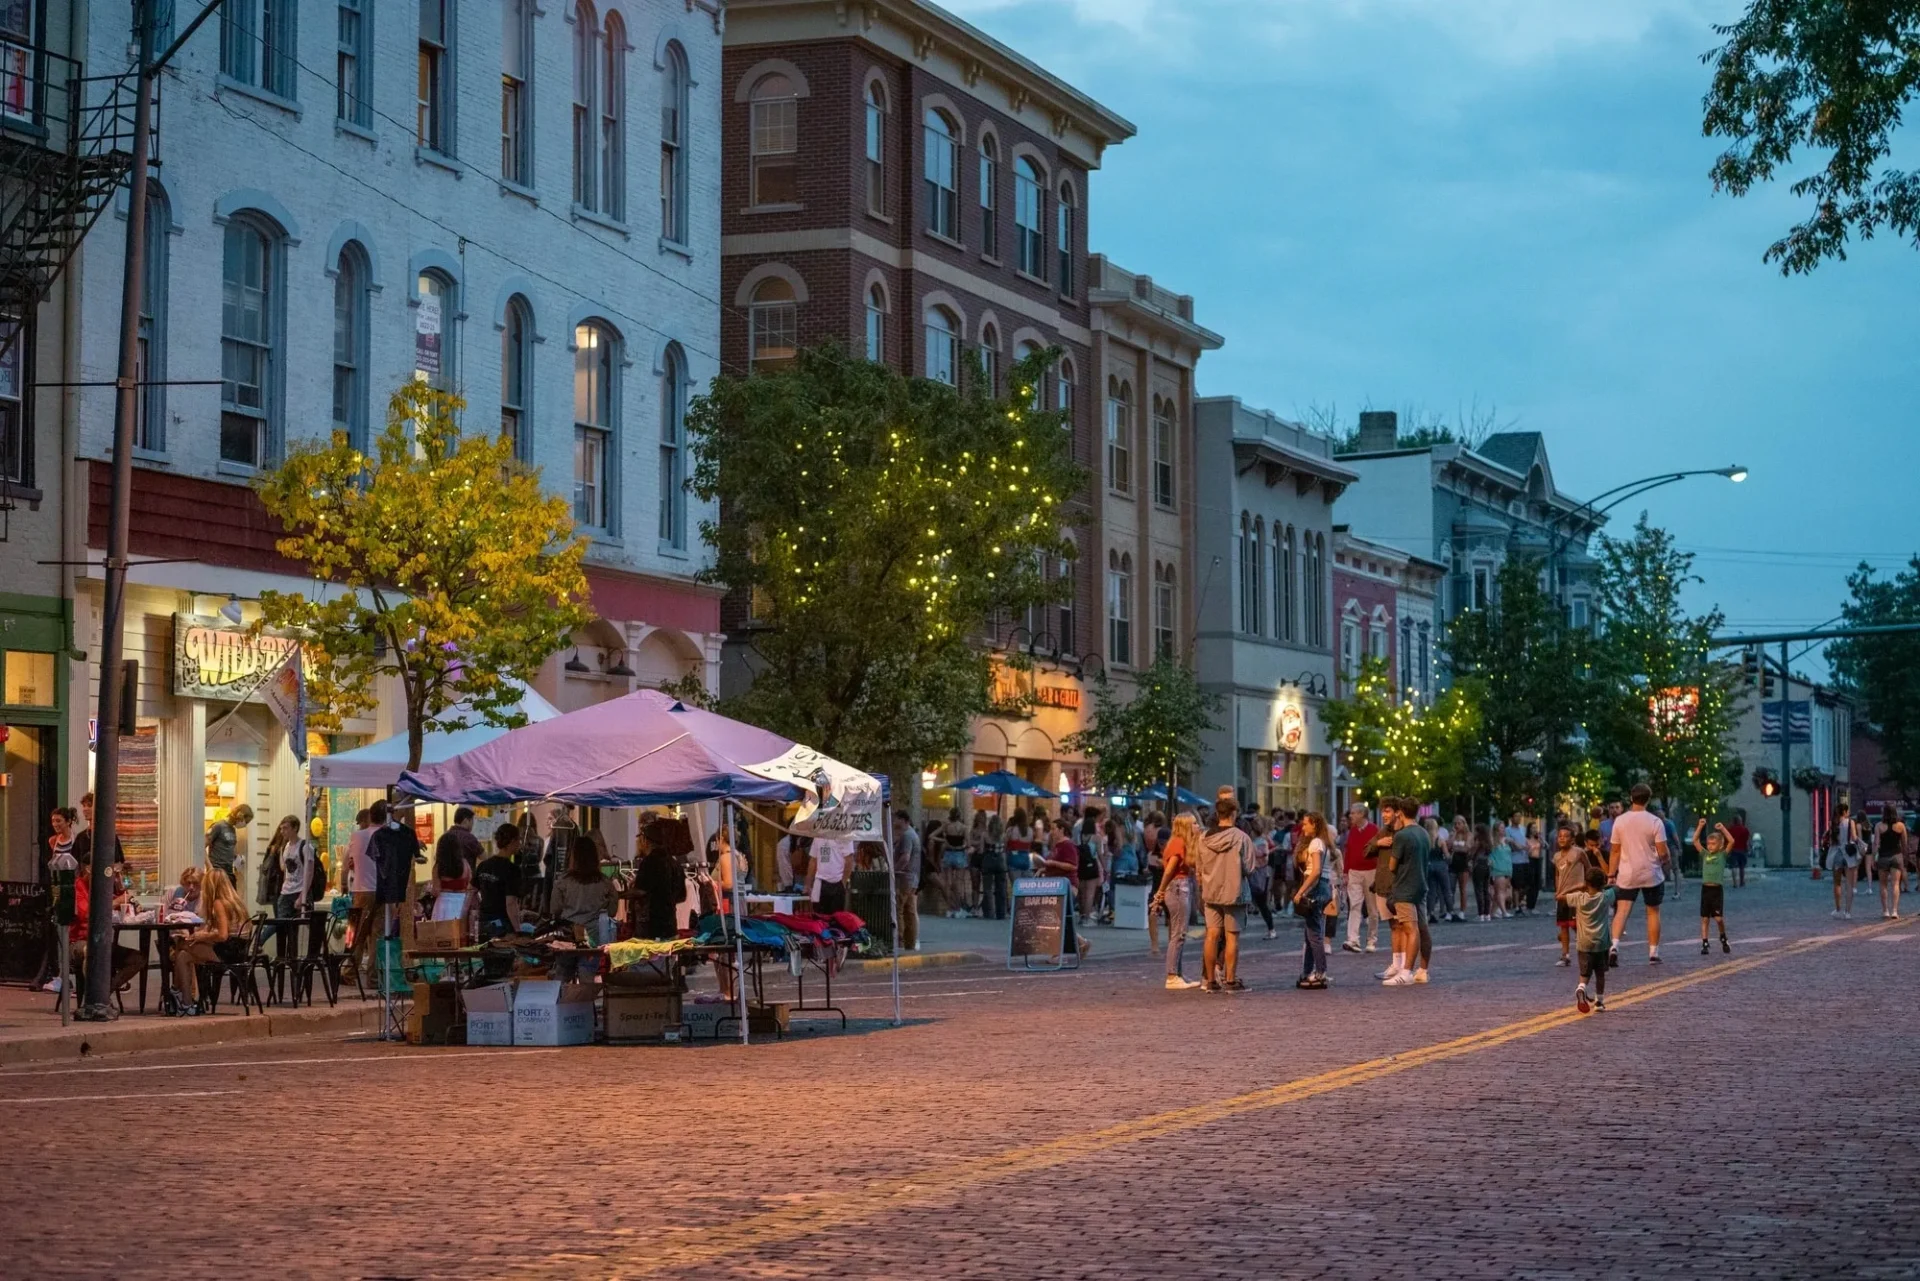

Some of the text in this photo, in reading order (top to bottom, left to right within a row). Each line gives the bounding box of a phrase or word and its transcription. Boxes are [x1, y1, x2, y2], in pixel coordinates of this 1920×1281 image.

[185, 627, 257, 685] WILD
[518, 1008, 551, 1017] PORT &
[683, 1013, 713, 1022] ILDAN
[470, 1021, 494, 1030] PORT
